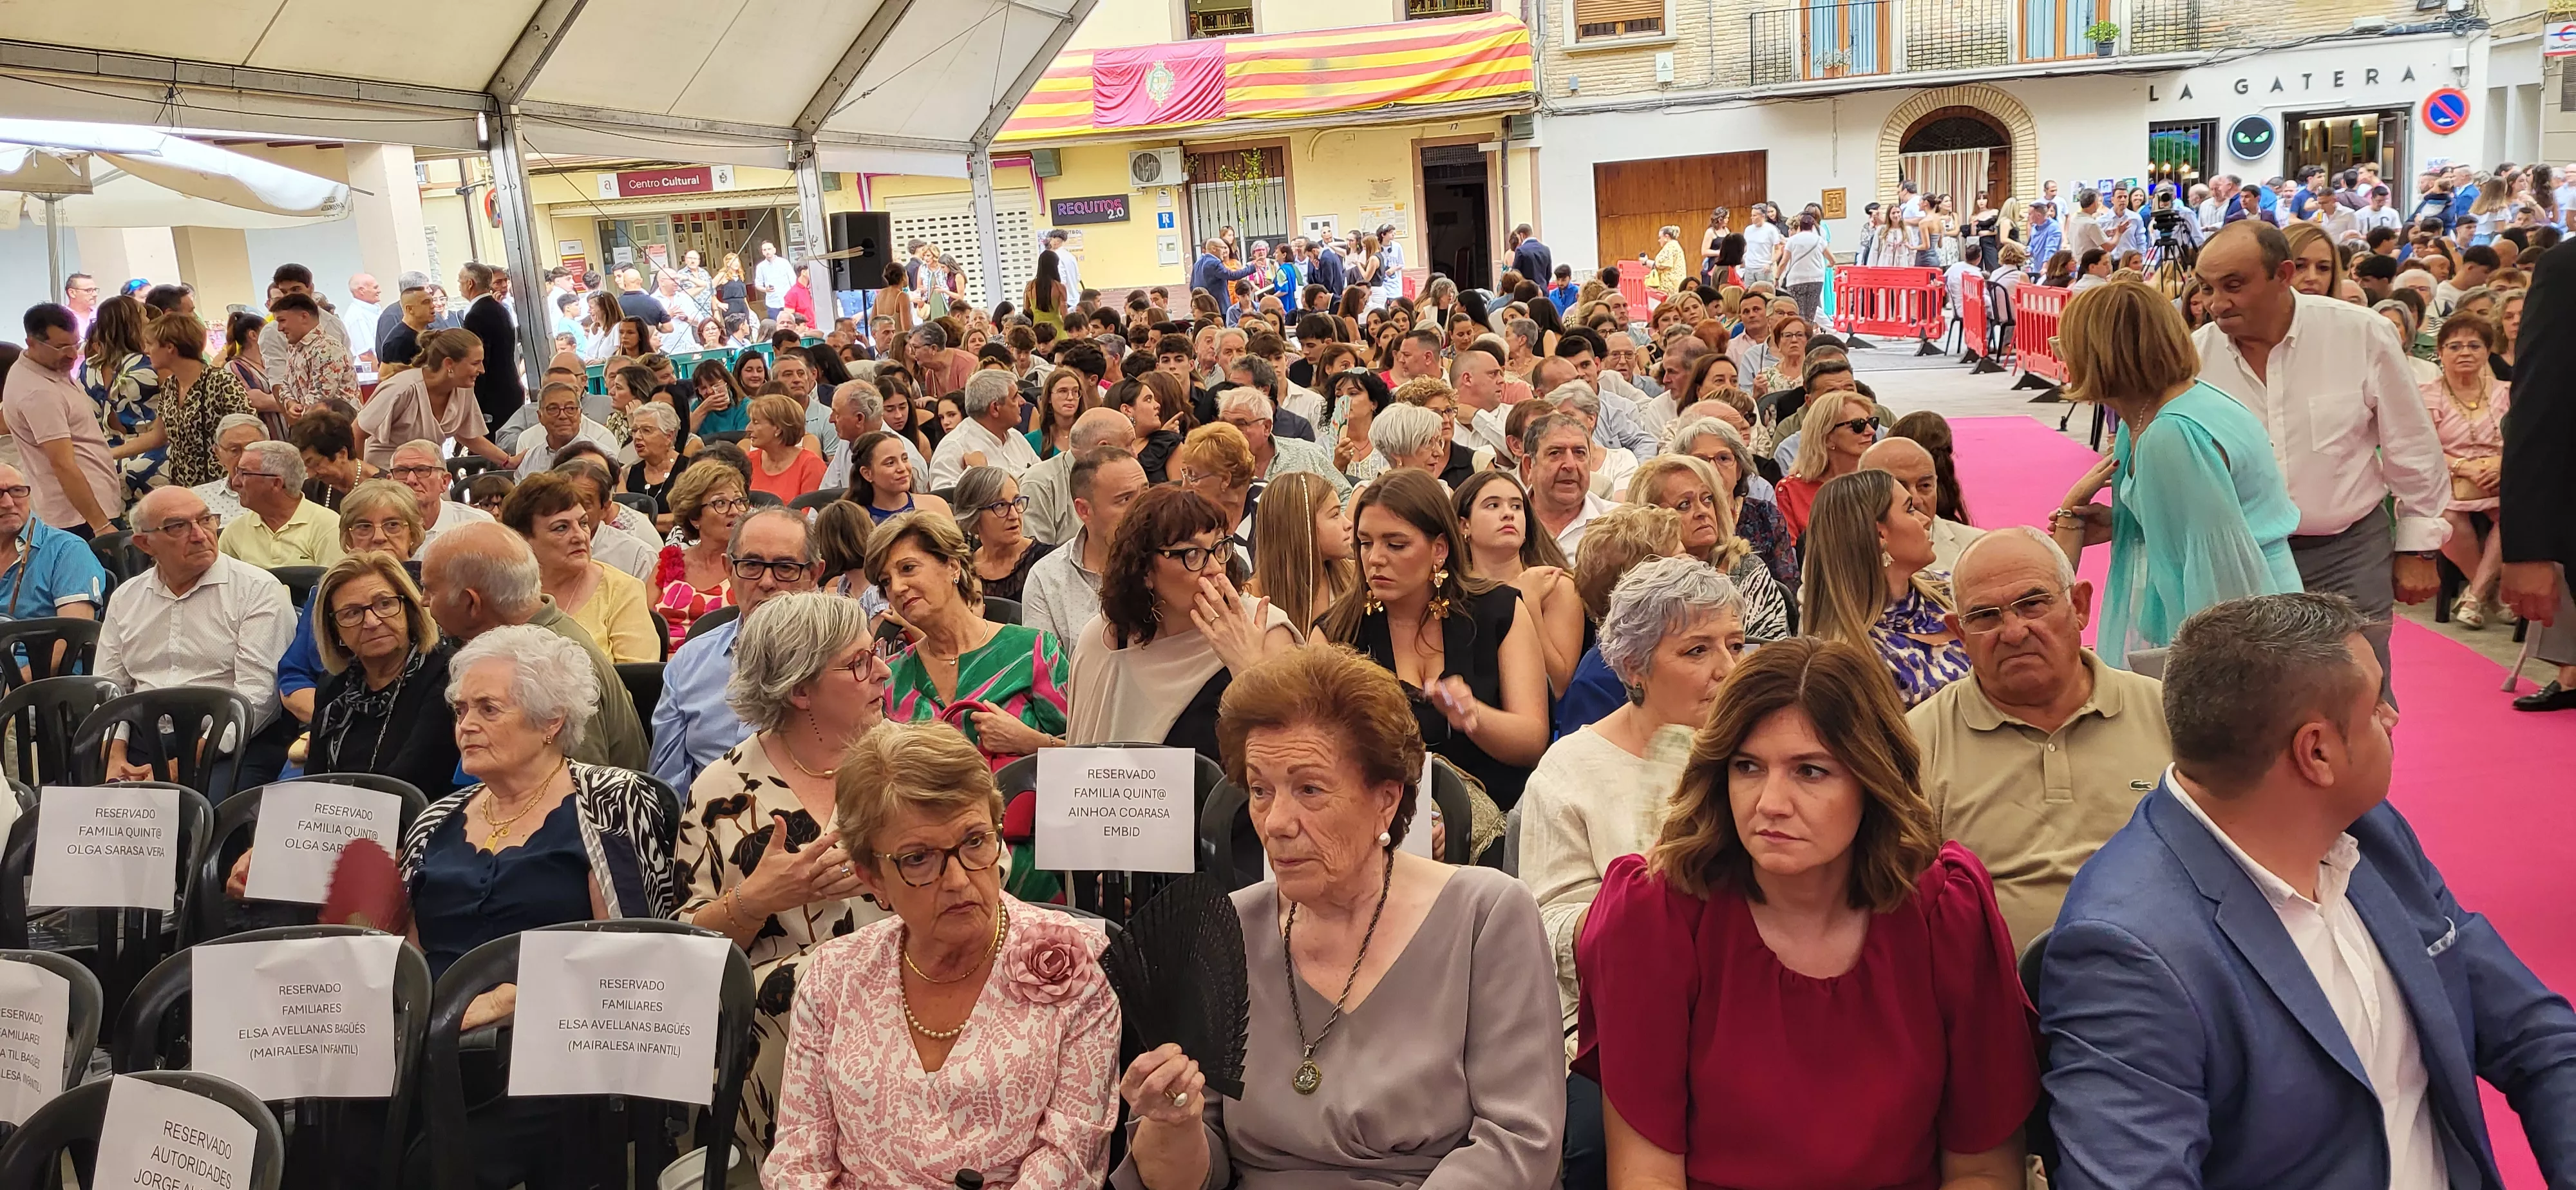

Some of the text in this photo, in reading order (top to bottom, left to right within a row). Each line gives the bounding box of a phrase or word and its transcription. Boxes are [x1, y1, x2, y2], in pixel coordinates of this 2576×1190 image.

[2149, 65, 2416, 102] LA GATERA
[629, 175, 699, 189] Centro Cultural
[1057, 199, 1122, 216] REQUITOS
[1107, 207, 1124, 220] 2.0
[1088, 769, 1156, 779] RESERVADO
[1074, 788, 1166, 800] FAMILIA QUINT@
[95, 808, 156, 819] RESERVADO
[314, 803, 373, 820] RESERVADO
[1068, 807, 1170, 818] AINHOA COARASA
[79, 826, 162, 839] FAMILIA QUINT@
[298, 820, 379, 840] FAMILIA QUINT@
[1104, 826, 1140, 836] EMBID
[67, 844, 165, 857] OLGA SARASA VERA
[285, 838, 343, 853] OLGA SAR
[279, 983, 341, 996] RESERVADO
[600, 979, 665, 990] RESERVADO
[282, 1003, 342, 1015] FAMILIARES
[602, 999, 663, 1012] FAMILIARES
[0, 1008, 43, 1025] ESERVADO
[239, 1021, 366, 1039] ELSA AVELLANAS BAGÜÉS
[558, 1019, 690, 1035] ELSA AVELLANAS BAGÜÉS
[8, 1049, 19, 1061] TIL
[249, 1044, 359, 1061] (MAIRALESA INFANTIL)
[568, 1040, 681, 1058] (MAIRALESA INFANTIL)
[163, 1120, 232, 1159] RESERVADO
[151, 1145, 232, 1189] AUTORIDADES
[133, 1169, 181, 1190] JORGE
